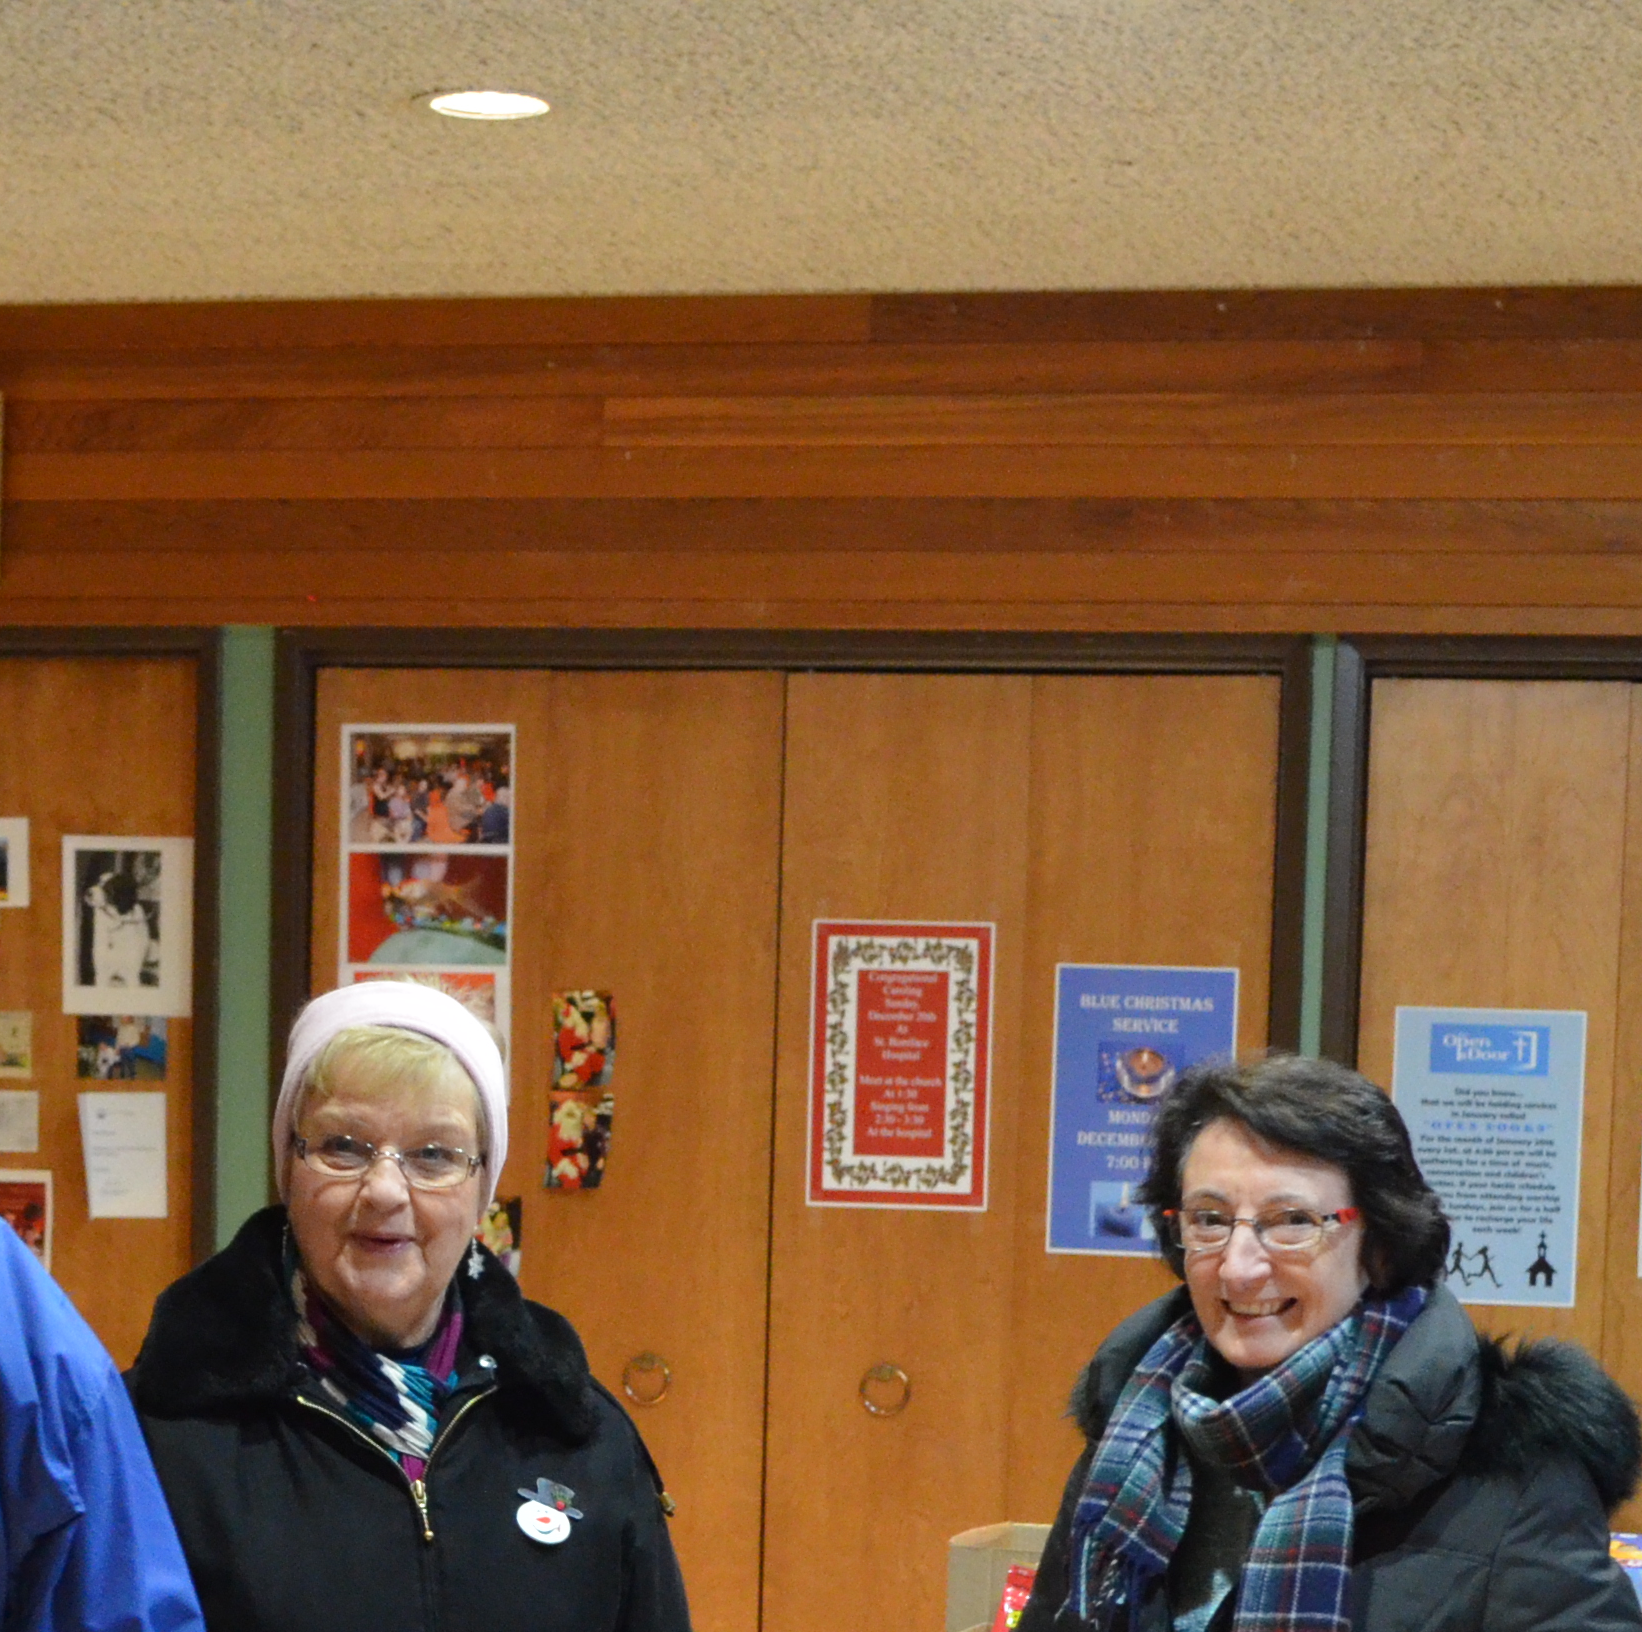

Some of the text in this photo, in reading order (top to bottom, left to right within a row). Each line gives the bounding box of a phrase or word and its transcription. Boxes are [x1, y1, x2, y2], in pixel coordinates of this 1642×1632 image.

[1079, 994, 1214, 1012] BLUE CHRISTMAS
[868, 1010, 914, 1021] December
[1112, 1017, 1179, 1033] SERVICE
[1443, 1032, 1492, 1061] Open
[1472, 1089, 1490, 1098] you
[1108, 1109, 1152, 1125] MOND
[1077, 1130, 1155, 1147] DECEMB
[1107, 1155, 1140, 1169] 7:00
